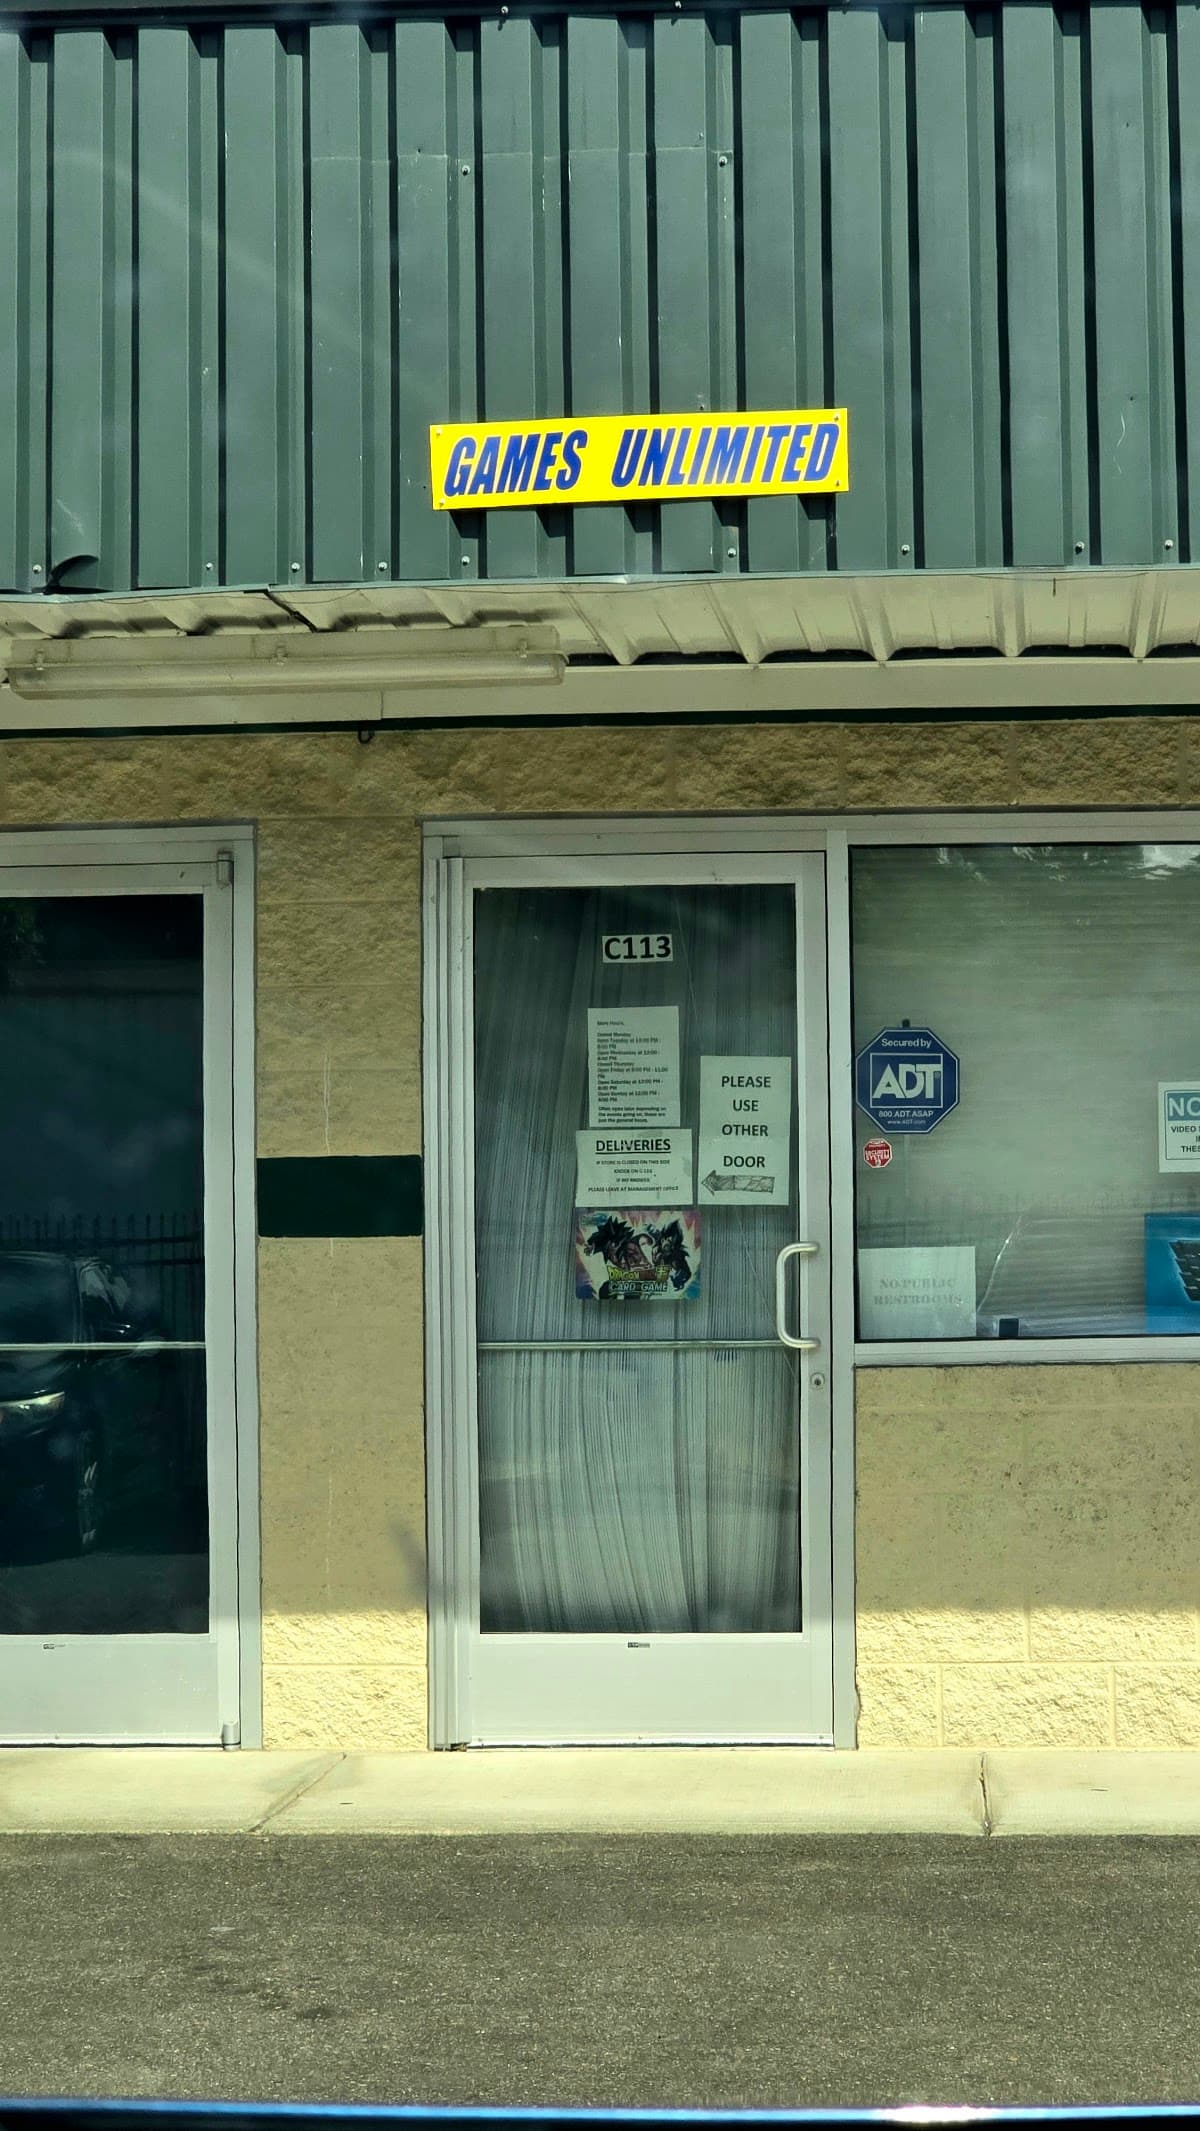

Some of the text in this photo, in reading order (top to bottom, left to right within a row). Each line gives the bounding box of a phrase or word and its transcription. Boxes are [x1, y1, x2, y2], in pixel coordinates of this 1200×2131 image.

[444, 424, 839, 496] GAMES UNLIMITED
[605, 936, 671, 959] C113
[881, 1038, 932, 1049] Secured by
[721, 1076, 771, 1088] PLEASE
[872, 1063, 943, 1099] ADT
[733, 1100, 759, 1111] USE
[722, 1124, 769, 1136] OTHER
[1170, 1125, 1197, 1133] VIDEO
[595, 1139, 671, 1153] DELIVERIES
[723, 1155, 766, 1168] DOOR
[610, 1282, 668, 1291] CARD GAME
[880, 1278, 957, 1289] NO PUBLIC
[874, 1294, 963, 1305] RESTROOMS
